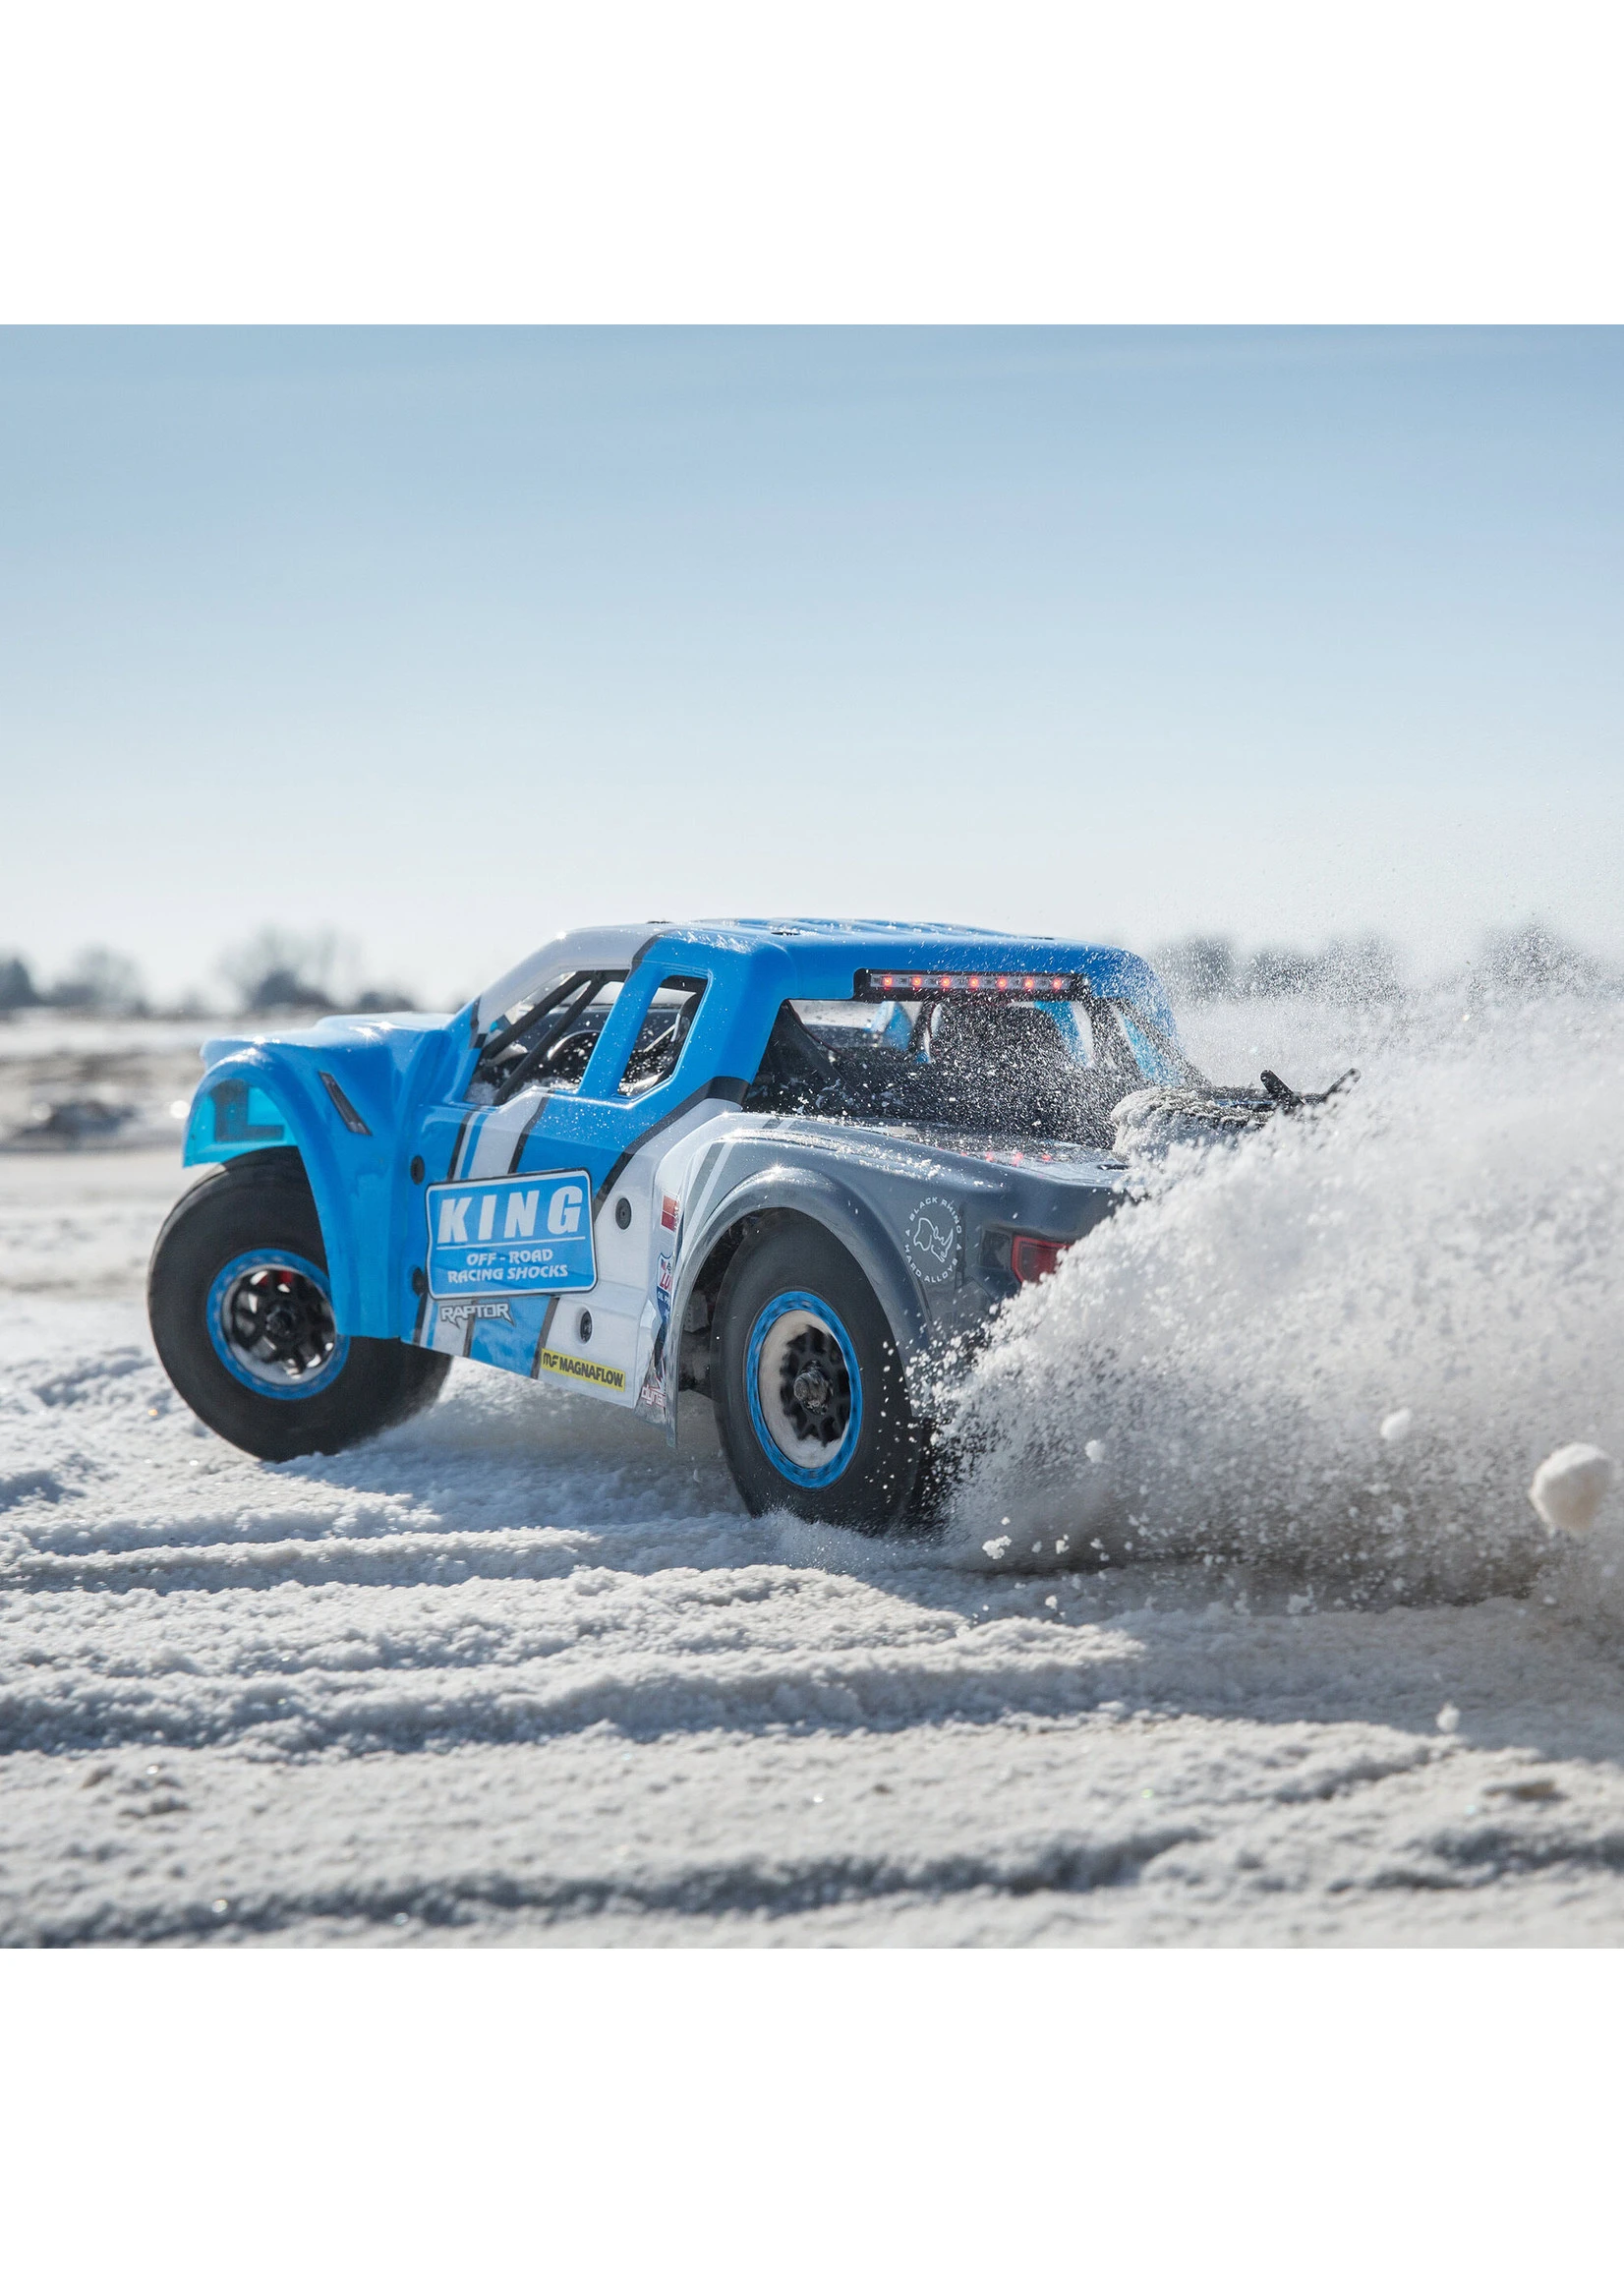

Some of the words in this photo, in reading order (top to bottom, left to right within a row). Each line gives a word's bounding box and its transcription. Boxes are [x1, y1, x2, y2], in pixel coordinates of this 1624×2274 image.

[437, 1186, 583, 1244] KING
[909, 1196, 938, 1221] BLACK
[941, 1199, 962, 1234] RHINO
[466, 1253, 496, 1266] OFF
[509, 1249, 553, 1264] ROAD
[904, 1244, 922, 1278] HARD
[924, 1257, 958, 1283] ALLOYS
[447, 1267, 504, 1284] RACING
[507, 1264, 568, 1280] SHOCKS
[439, 1302, 515, 1329] RAPTOR
[559, 1357, 623, 1387] MAGNAFLOW
